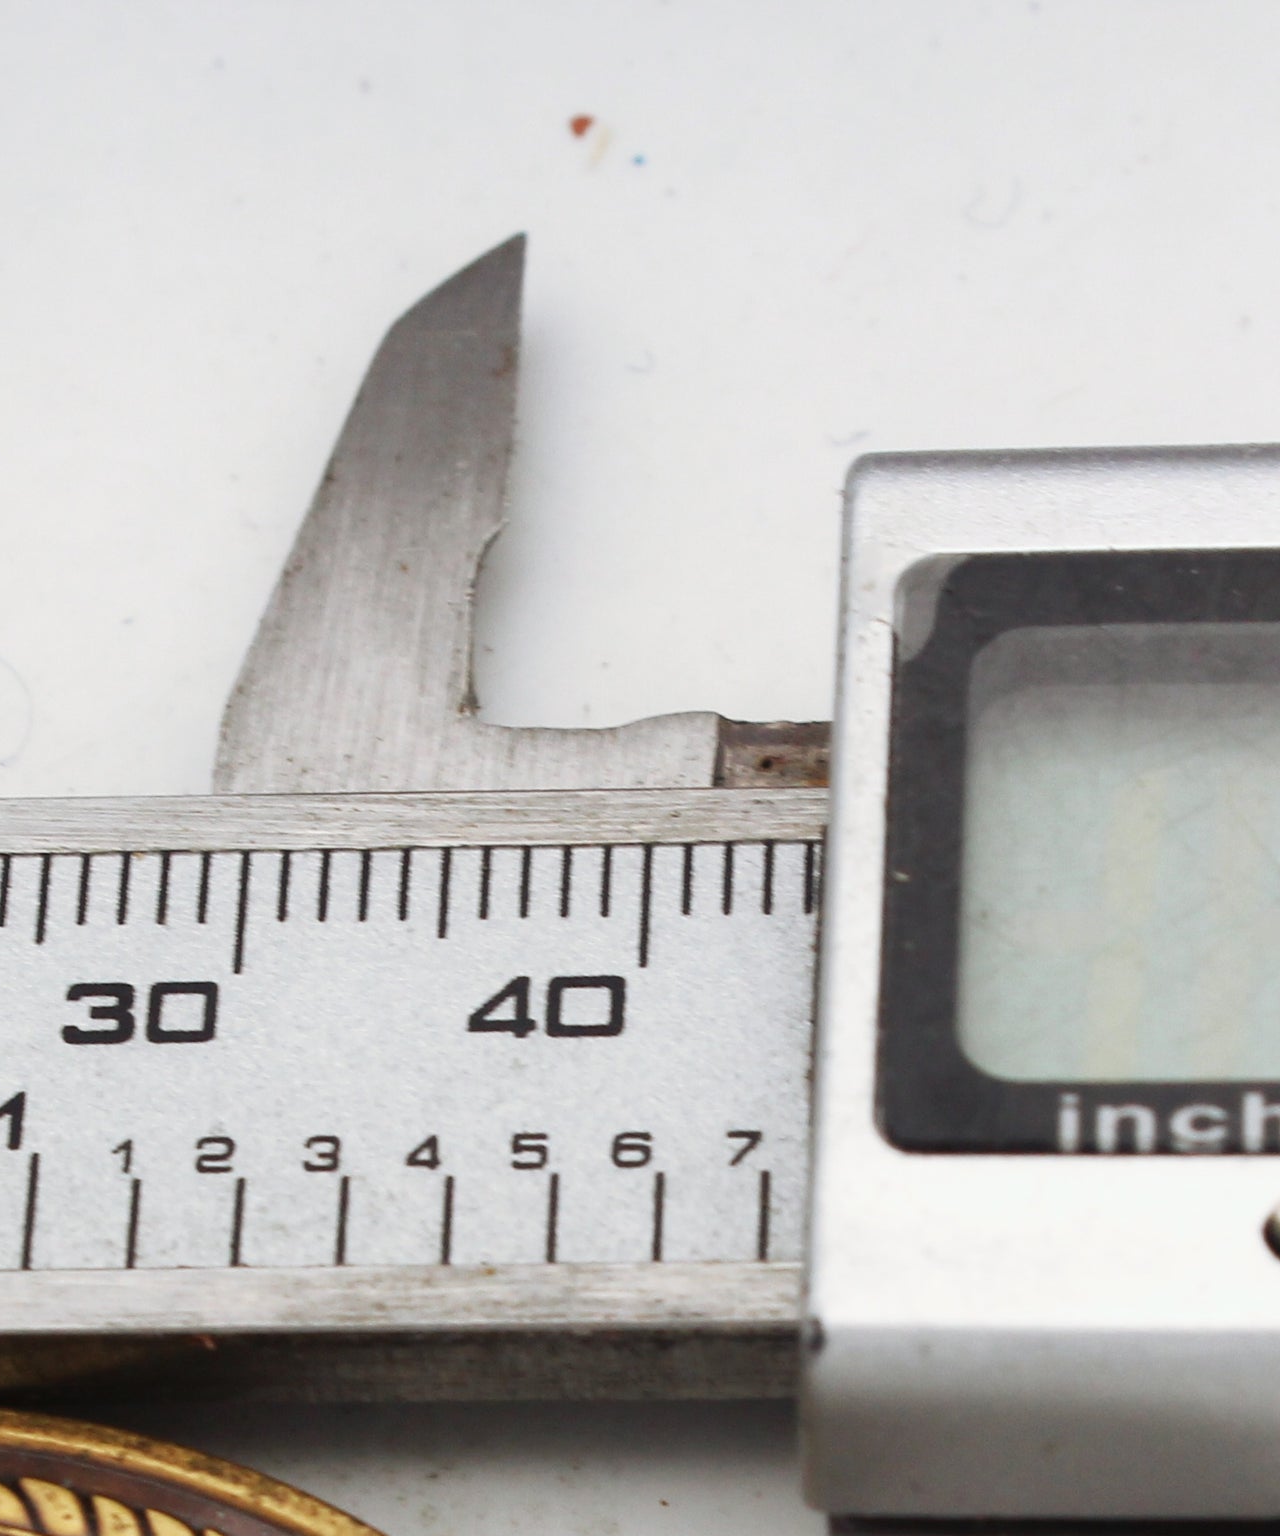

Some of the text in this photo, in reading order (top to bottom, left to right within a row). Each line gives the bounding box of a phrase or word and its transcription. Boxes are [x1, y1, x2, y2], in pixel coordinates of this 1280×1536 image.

[60, 980, 220, 1046] 30
[466, 974, 627, 1039] 40
[112, 1139, 133, 1174] 1
[195, 1135, 236, 1174] 2
[302, 1135, 342, 1173] 3
[405, 1134, 441, 1171] 4
[510, 1132, 549, 1171] 5
[610, 1131, 653, 1169] 6
[726, 1129, 763, 1167] 7
